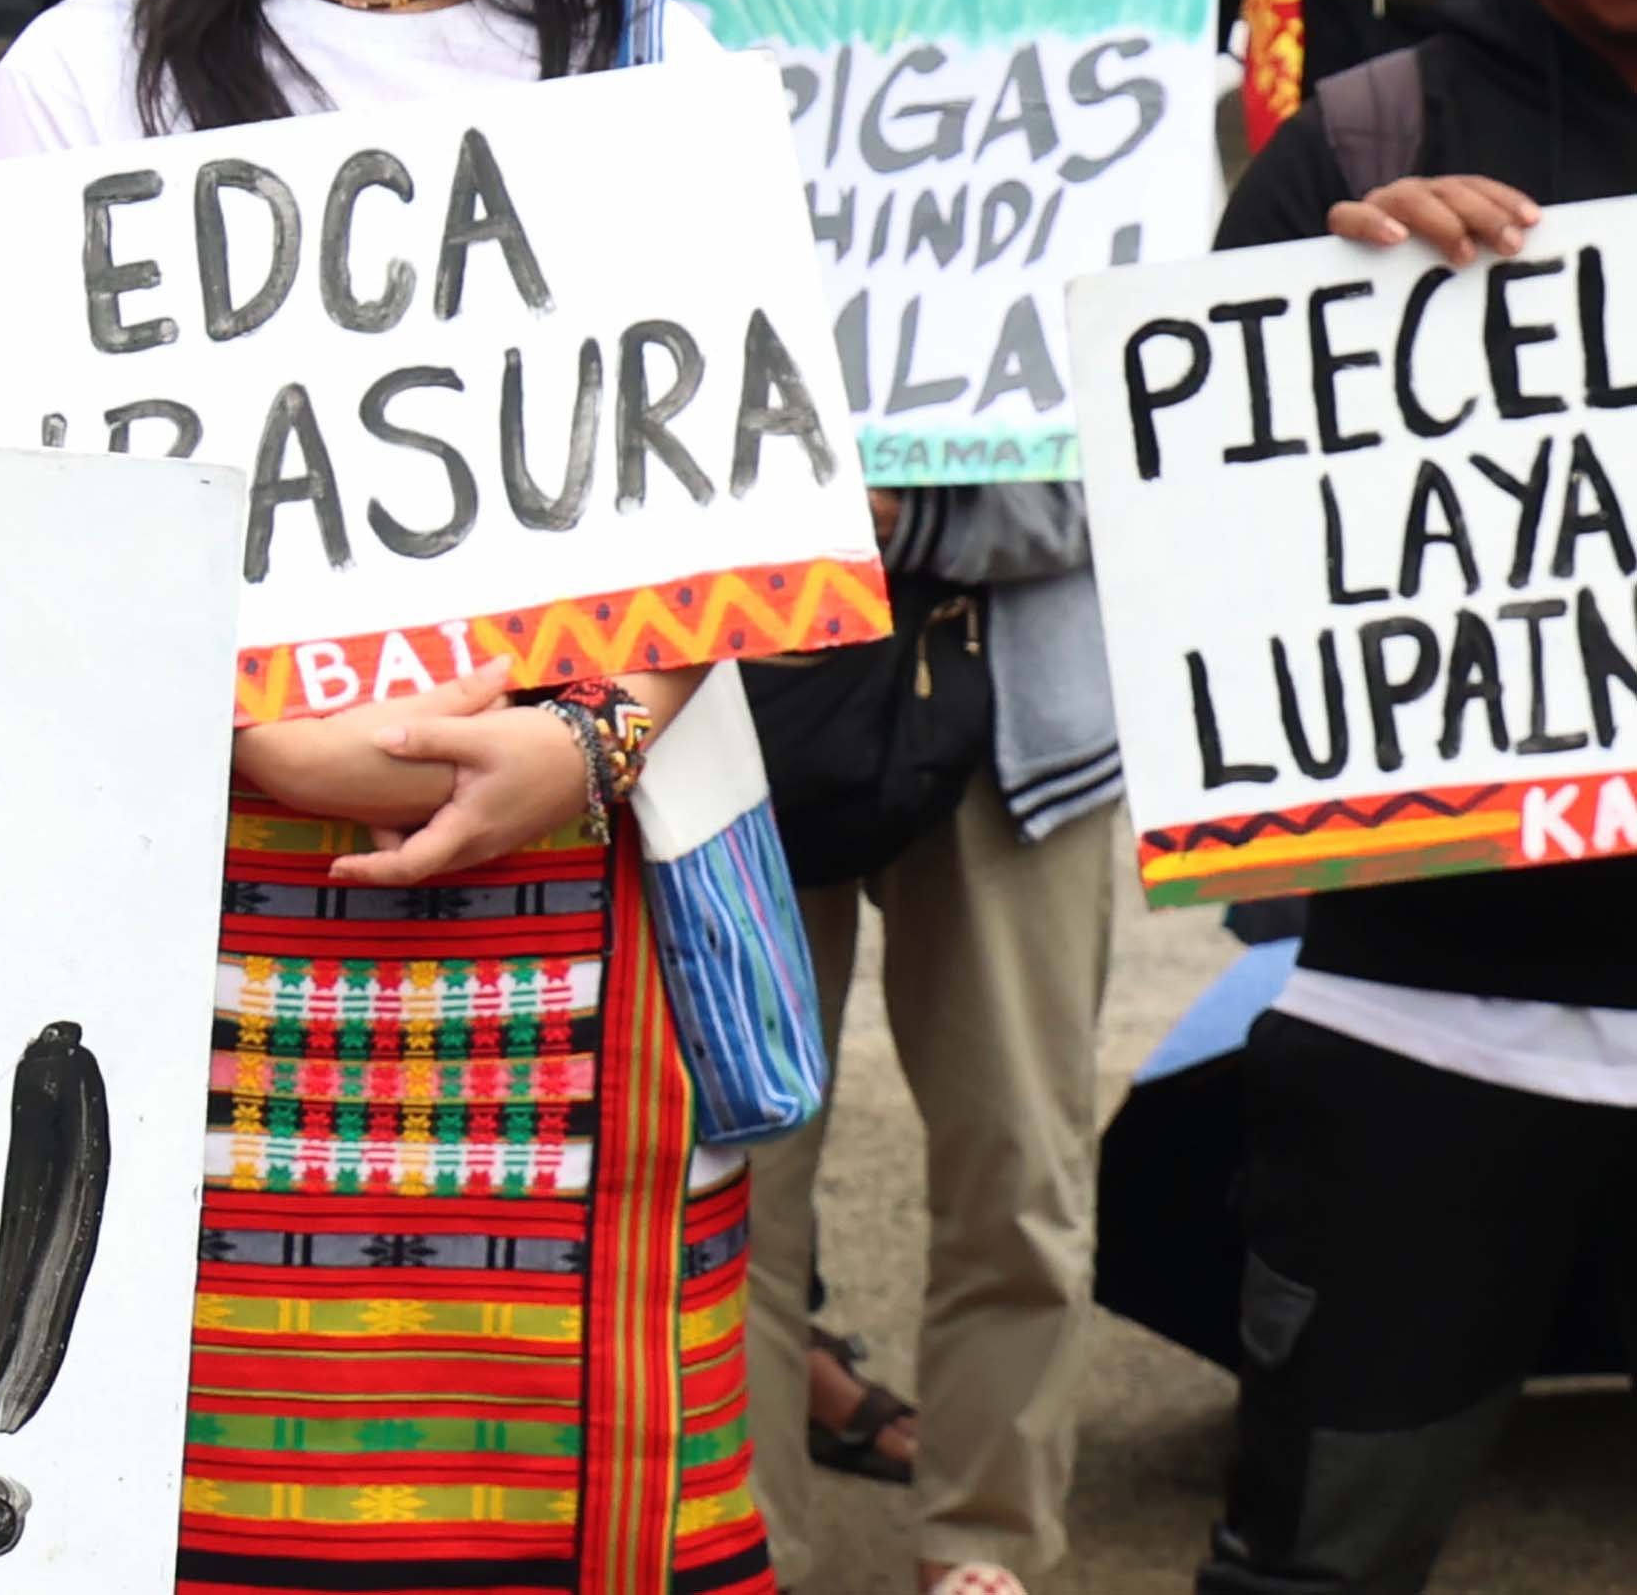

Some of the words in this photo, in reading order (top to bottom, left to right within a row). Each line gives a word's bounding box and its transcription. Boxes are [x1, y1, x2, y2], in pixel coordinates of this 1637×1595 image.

[82, 127, 556, 355] EDCA
[804, 178, 1069, 270] HINDI
[40, 307, 838, 585] ASURA
[857, 432, 1078, 476] SAMA-T
